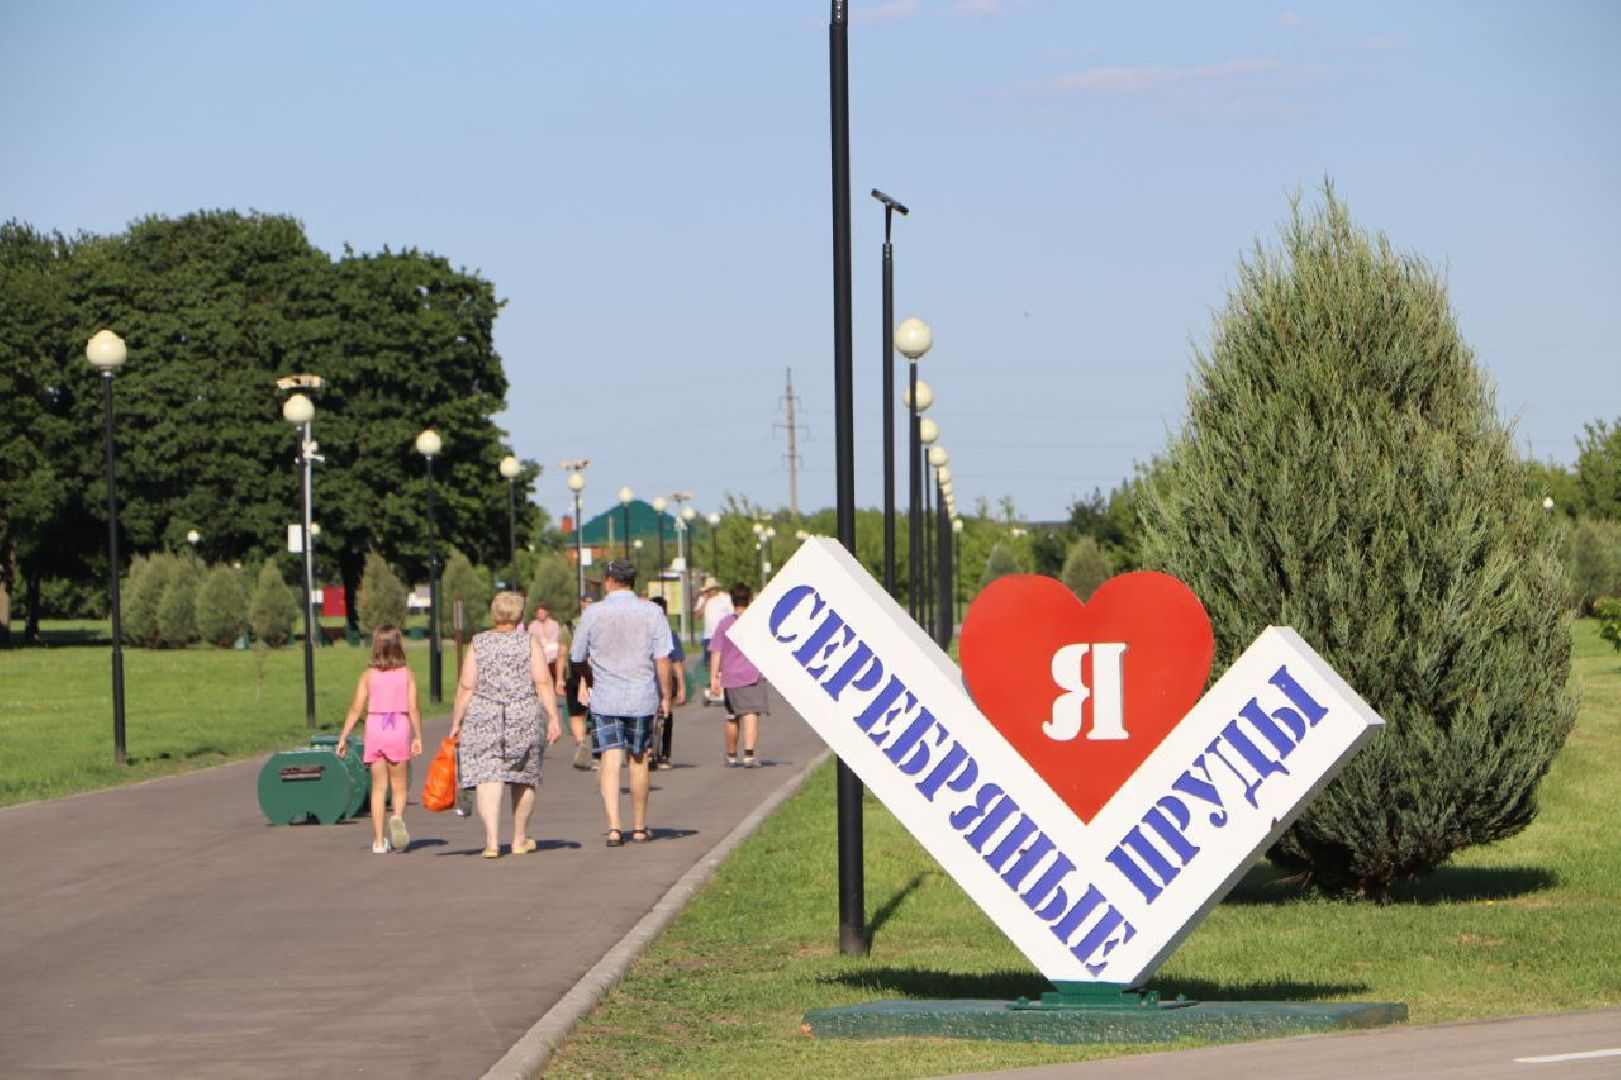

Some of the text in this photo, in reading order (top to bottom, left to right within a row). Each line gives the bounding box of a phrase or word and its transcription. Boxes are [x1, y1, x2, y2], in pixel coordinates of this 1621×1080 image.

[769, 585, 1138, 977] СЕРЕБРЯНЫЕ
[1042, 643, 1130, 741] Я
[1105, 664, 1329, 905] ПРУДЫ
